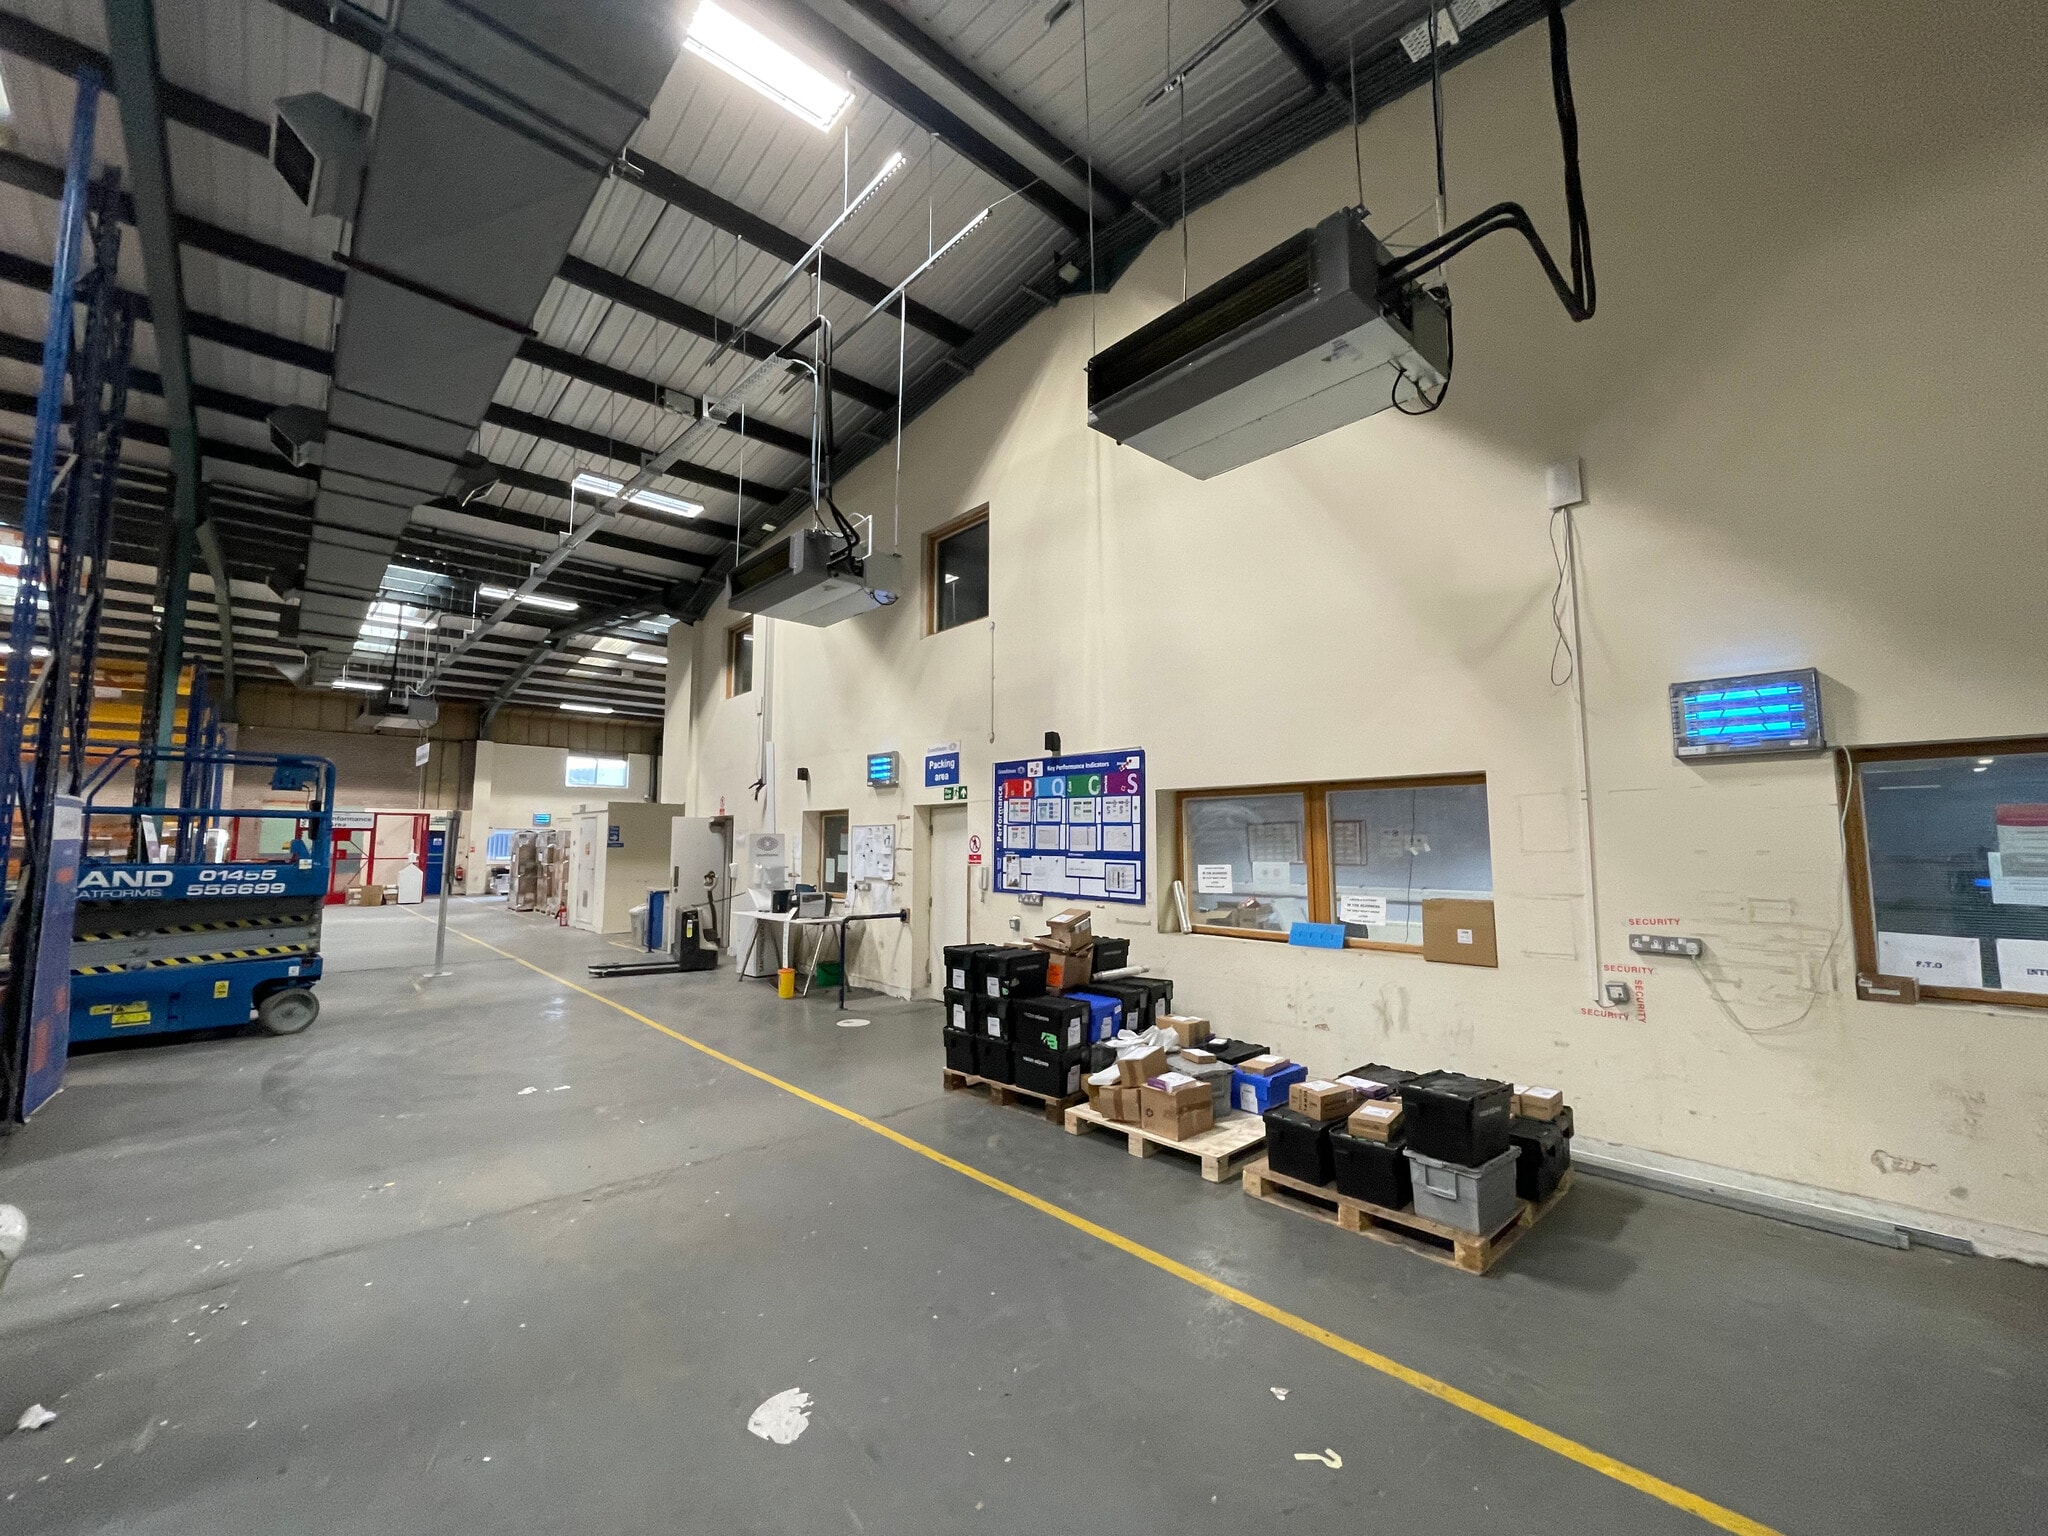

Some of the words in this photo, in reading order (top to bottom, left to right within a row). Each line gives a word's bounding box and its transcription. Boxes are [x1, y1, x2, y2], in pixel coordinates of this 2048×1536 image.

[929, 759, 955, 770] Packing
[935, 773, 949, 781] area
[1023, 780, 1032, 798] P
[1127, 773, 1138, 794] S
[78, 870, 174, 888] AND
[199, 870, 277, 881] 01455
[187, 883, 286, 896] 556699
[1629, 918, 1680, 926] SECURITY
[1604, 965, 1654, 975] SECURITY
[1916, 961, 1943, 969] P.T.O
[1634, 980, 1647, 1023] SECURITY
[1581, 1008, 1629, 1020] SECURITY
